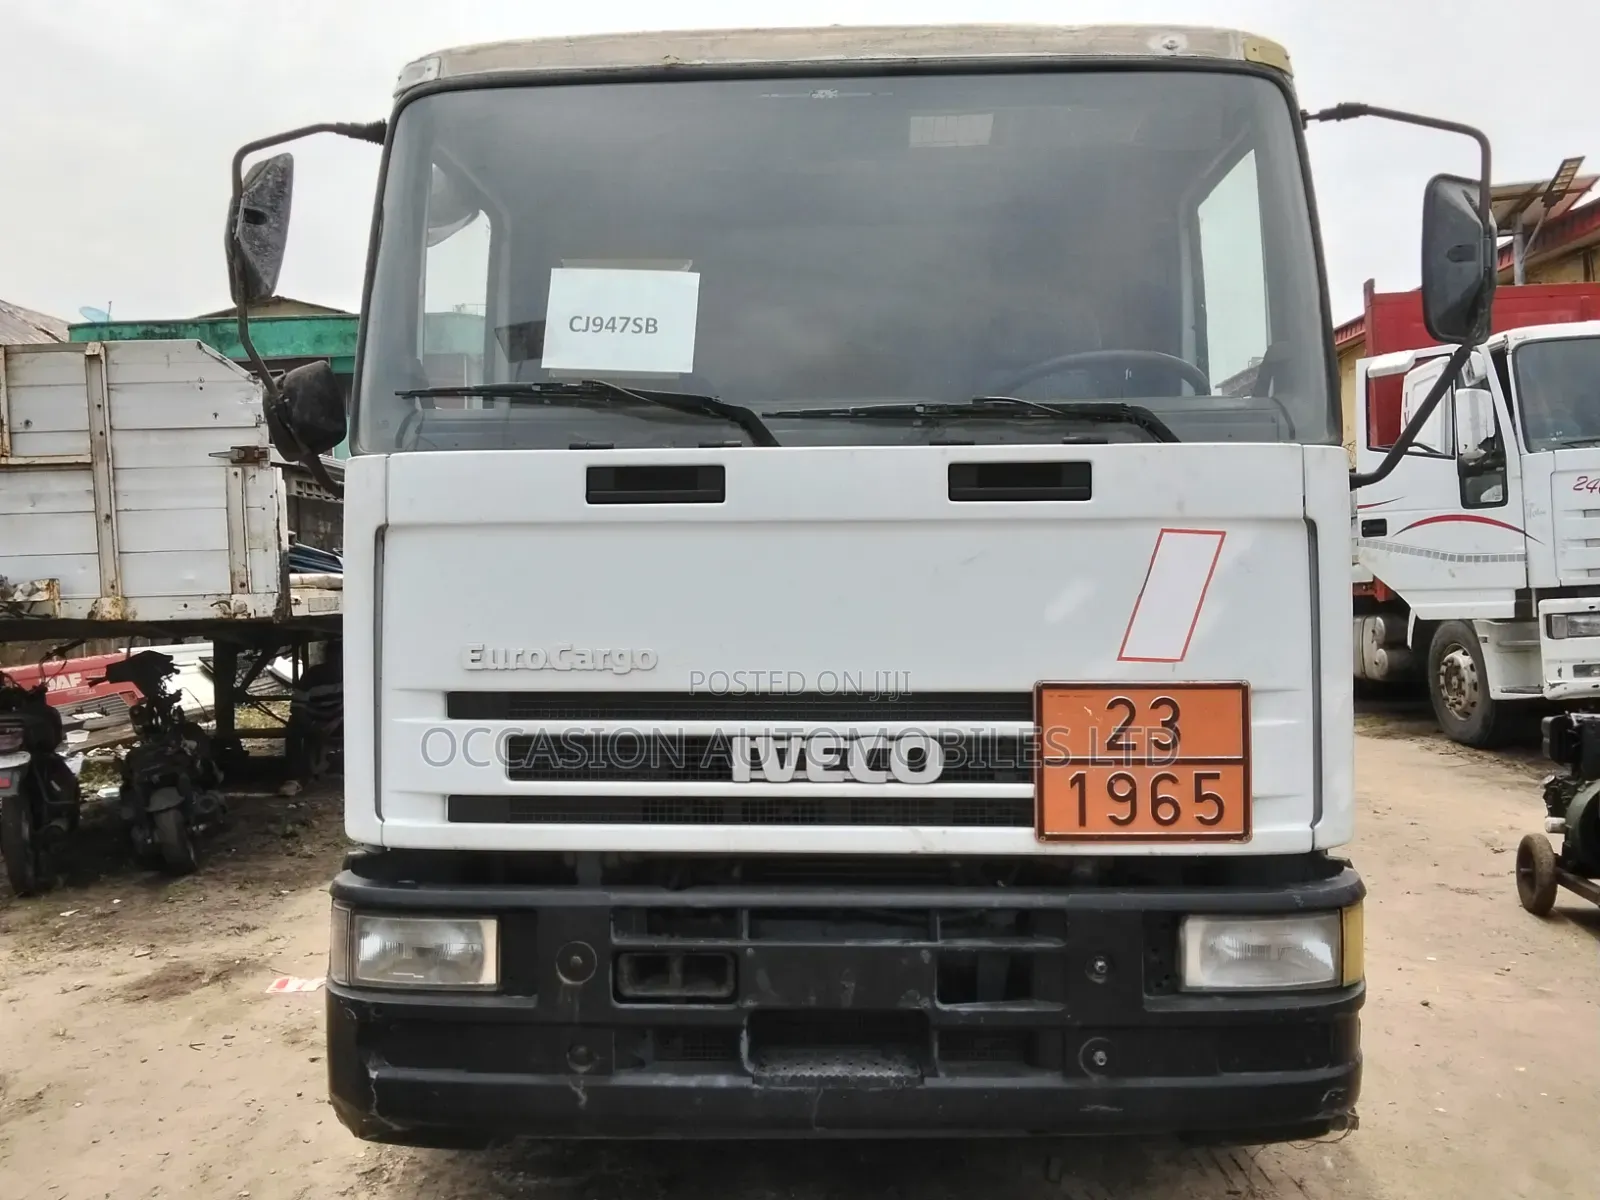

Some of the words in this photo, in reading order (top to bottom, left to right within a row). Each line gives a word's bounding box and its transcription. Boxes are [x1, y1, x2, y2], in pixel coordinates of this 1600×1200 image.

[569, 315, 658, 334] CJ947SB
[1572, 475, 1600, 494] 24
[463, 643, 658, 674] EuroCargo
[1105, 696, 1182, 751] 23
[732, 736, 945, 783] IVECO
[1069, 770, 1226, 827] 1965
